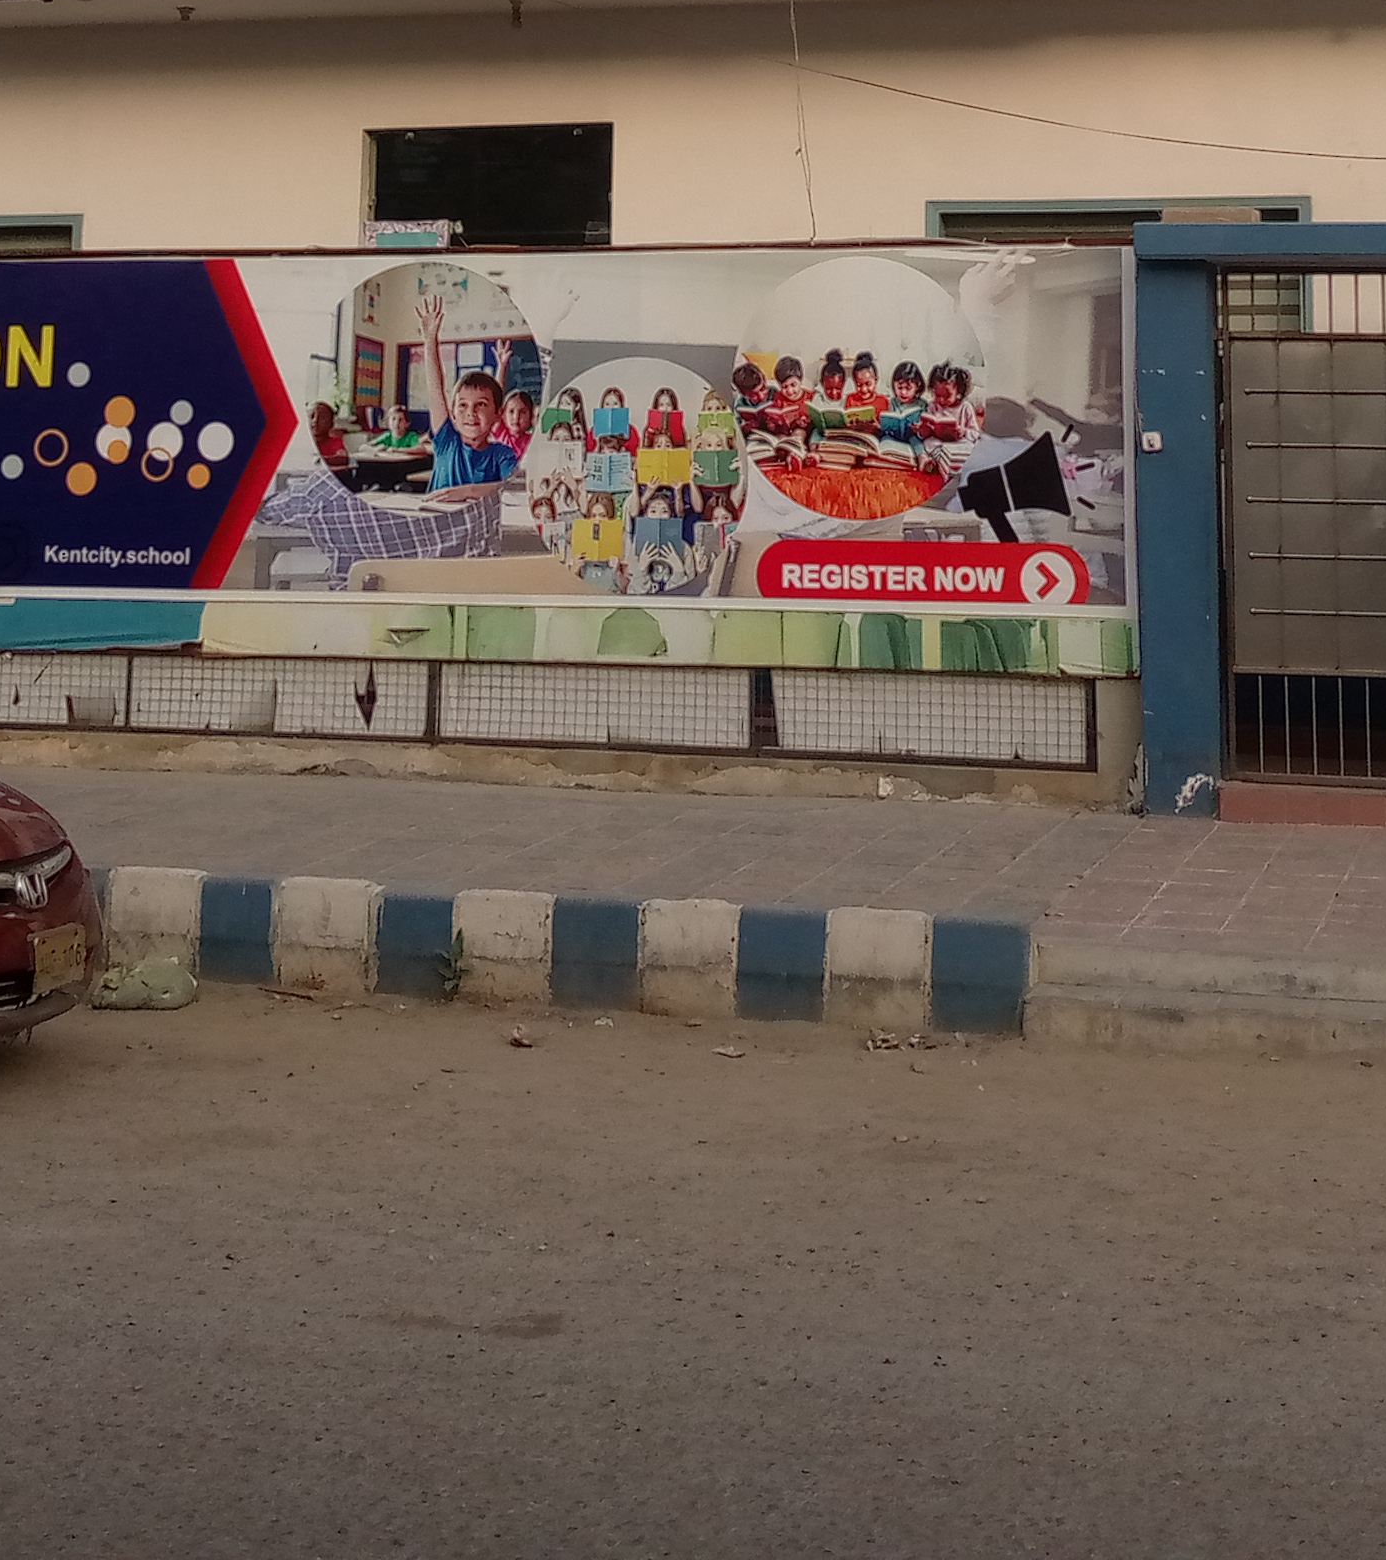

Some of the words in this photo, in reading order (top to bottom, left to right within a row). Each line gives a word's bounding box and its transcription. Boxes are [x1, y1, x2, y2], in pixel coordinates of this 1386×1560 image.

[43, 545, 191, 567] Kentcity.school
[781, 562, 928, 592] REGISTER
[933, 566, 1005, 593] NOW
